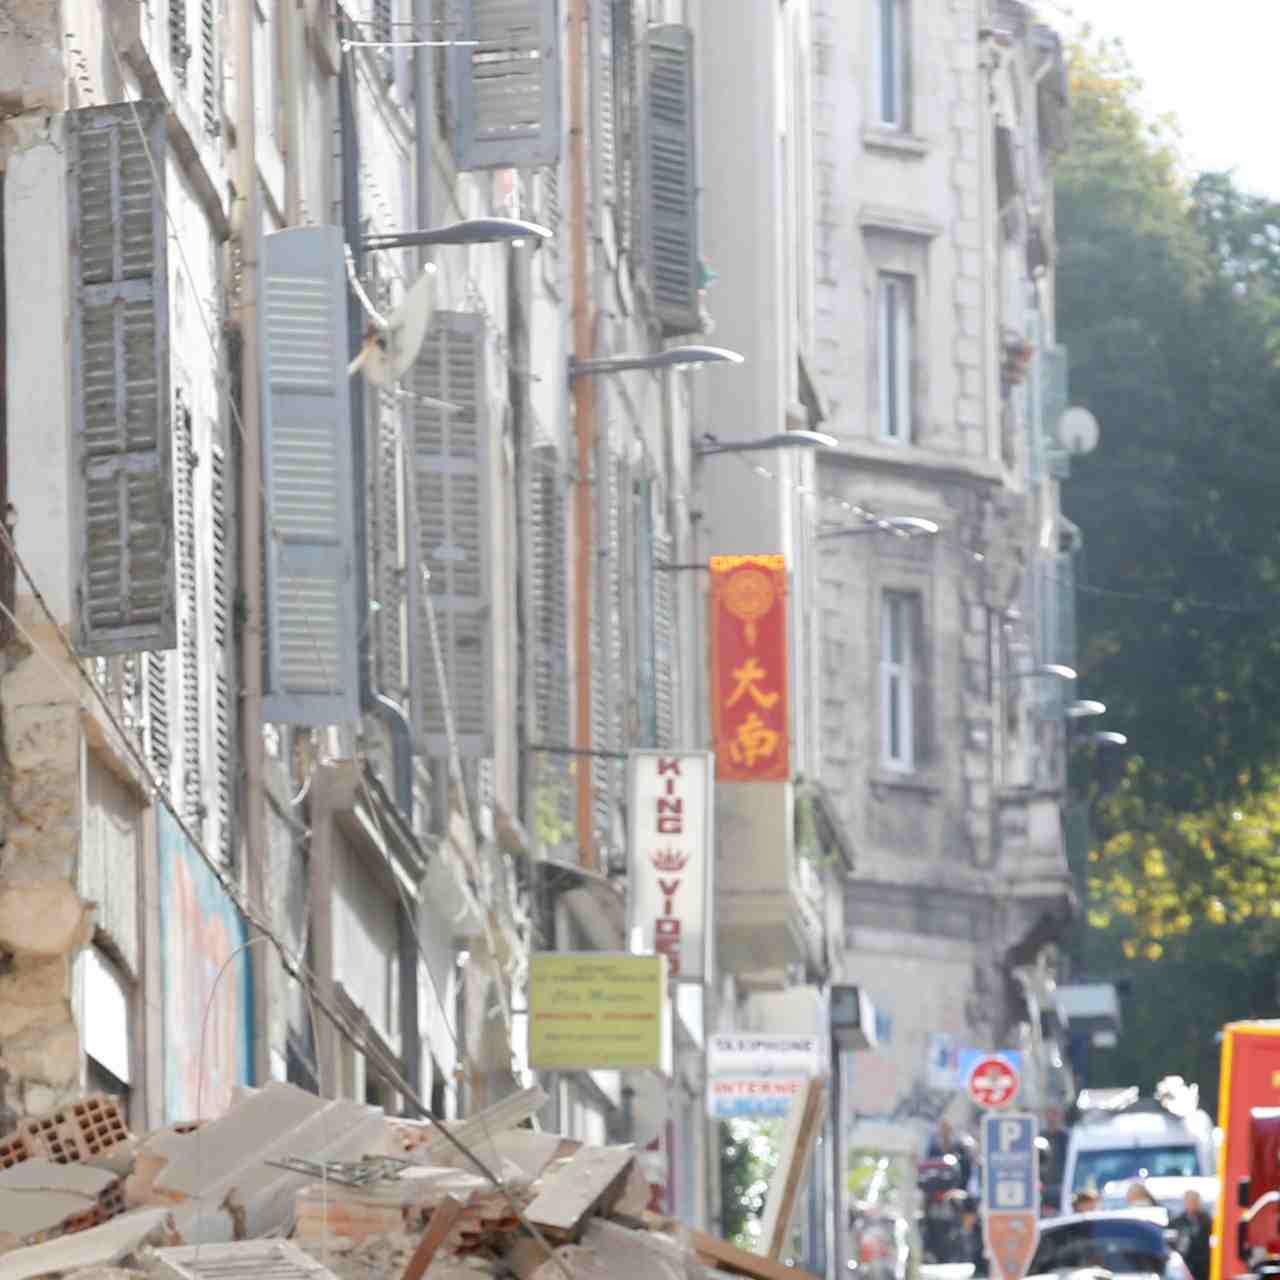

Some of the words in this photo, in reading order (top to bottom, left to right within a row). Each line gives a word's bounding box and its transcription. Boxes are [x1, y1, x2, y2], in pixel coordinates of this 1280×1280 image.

[726, 656, 780, 769] 大南
[655, 756, 683, 834] KING
[999, 1119, 1021, 1153] P
